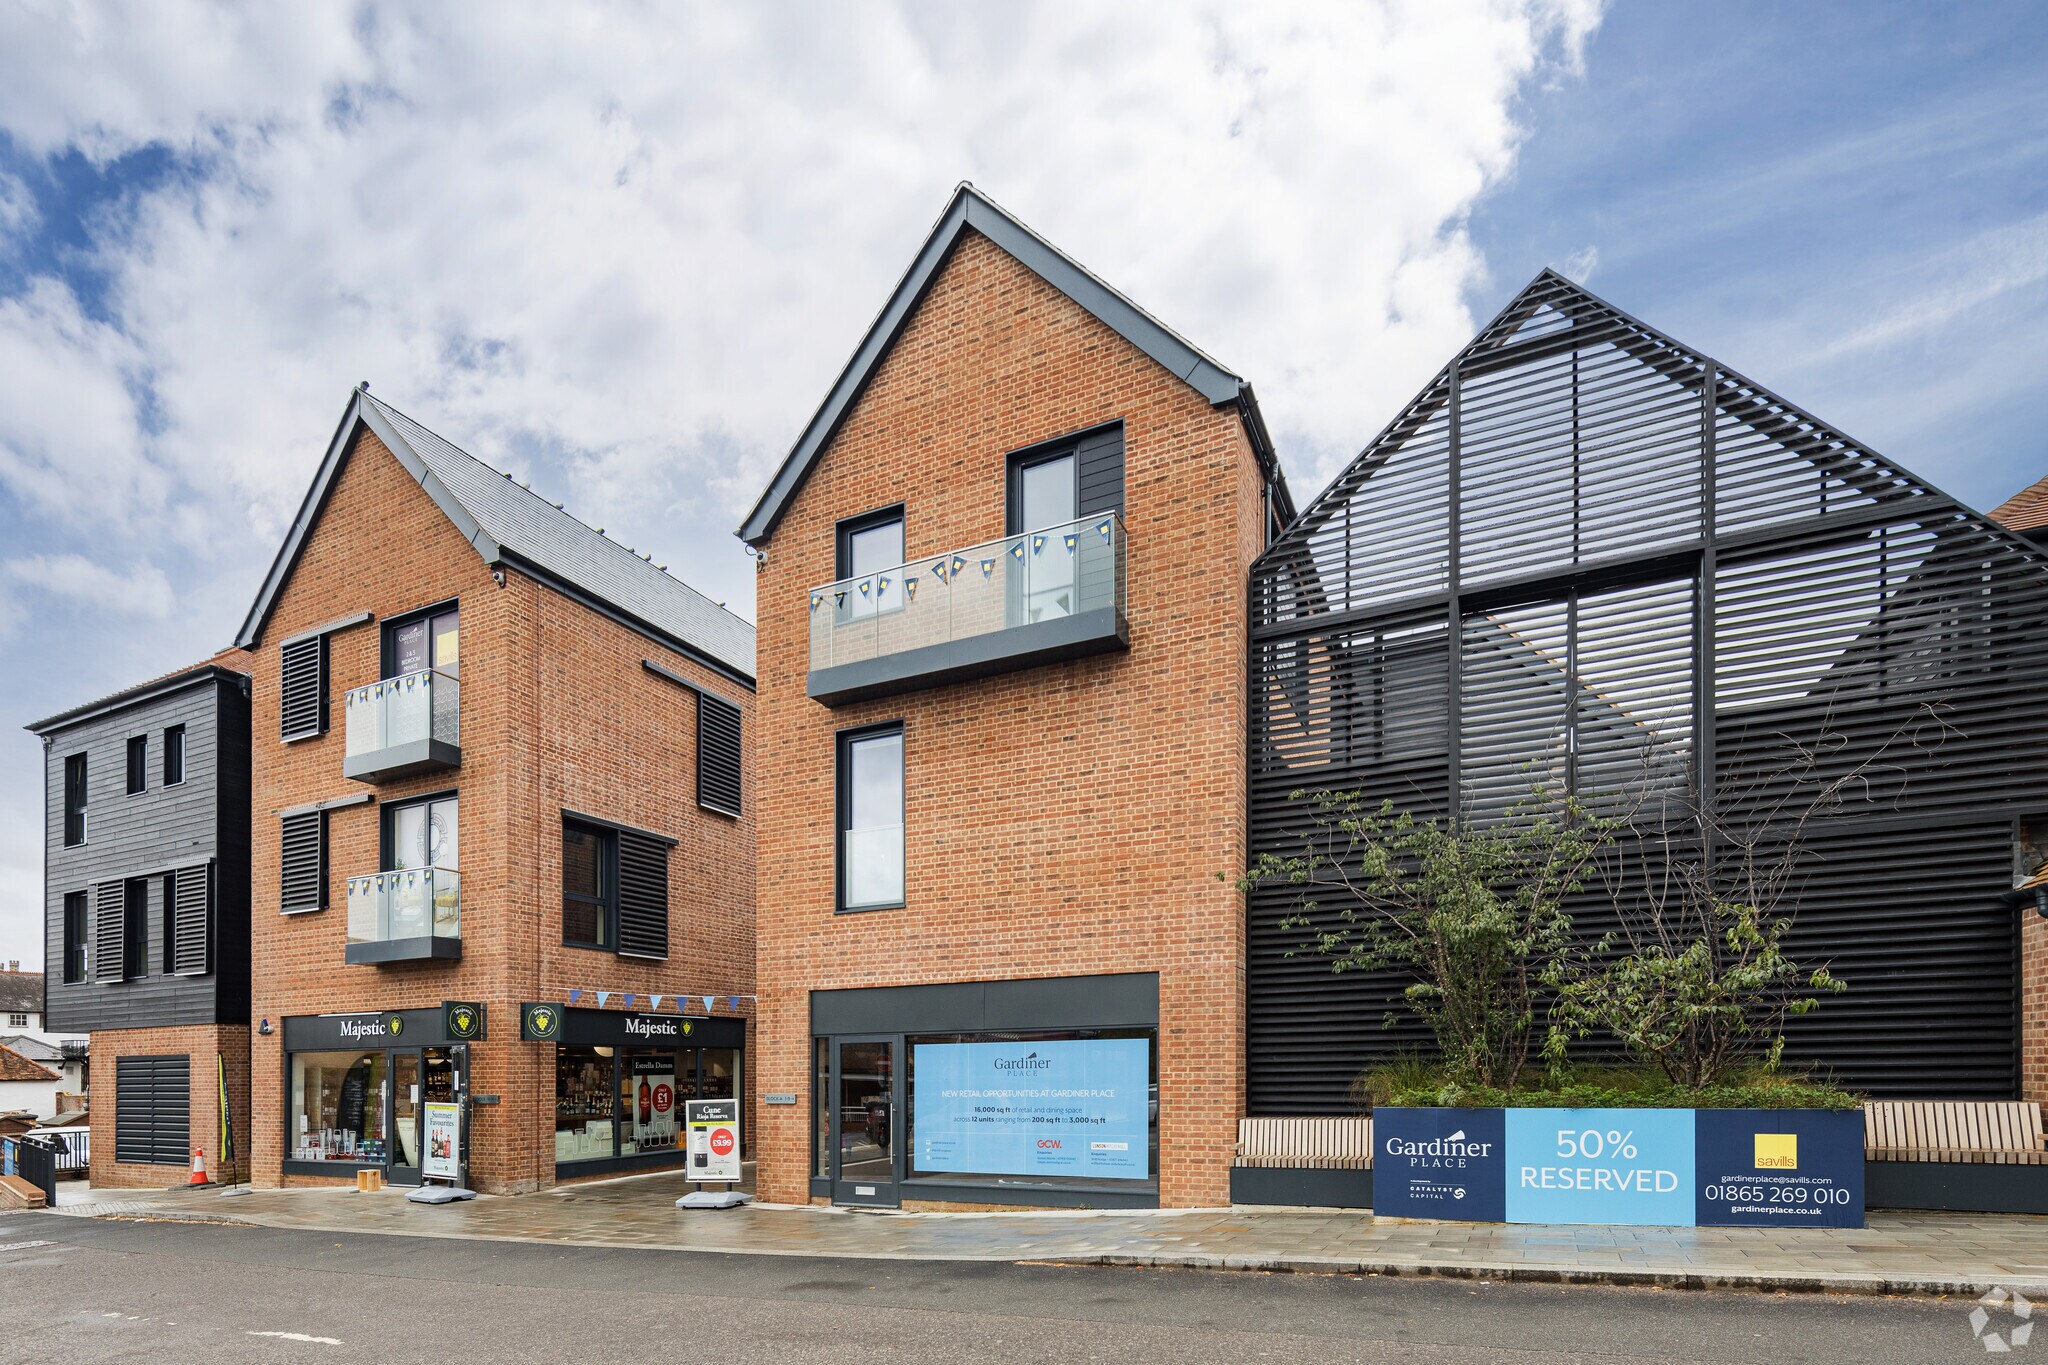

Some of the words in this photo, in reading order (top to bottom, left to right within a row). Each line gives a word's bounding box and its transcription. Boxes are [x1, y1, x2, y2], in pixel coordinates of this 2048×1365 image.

[340, 1019, 386, 1041] Majestic
[625, 1018, 677, 1039] Majestic
[635, 1061, 654, 1069] Estrella
[655, 1061, 673, 1069] Damm
[994, 1056, 1051, 1070] Gardiner
[657, 1092, 668, 1104] £1
[942, 1090, 959, 1098] NEW
[959, 1090, 982, 1098] RETAIL
[983, 1090, 1039, 1098] OPPORTUNITIES
[1040, 1090, 1050, 1098] AT
[1051, 1090, 1090, 1098] GARDINER
[1091, 1090, 1115, 1098] PLACE
[431, 1110, 453, 1119] Summer
[703, 1105, 722, 1114] Cune
[1046, 1106, 1064, 1114] dining
[430, 1118, 455, 1127] Favourites
[995, 1116, 1016, 1124] ranging
[712, 1139, 732, 1147] £9.99
[1386, 1135, 1492, 1157] Gardiner
[1556, 1129, 1638, 1159] 50%
[1410, 1157, 1467, 1168] PLACE
[1757, 1155, 1795, 1167] savills
[1521, 1166, 1679, 1193] RESERVED
[1721, 1175, 1832, 1185] gardinerplace@savills.com
[1705, 1185, 1764, 1202] 01865
[1769, 1186, 1808, 1203] 269
[1813, 1188, 1850, 1205] 010
[1731, 1205, 1822, 1215] gardinerplace.co.uk
